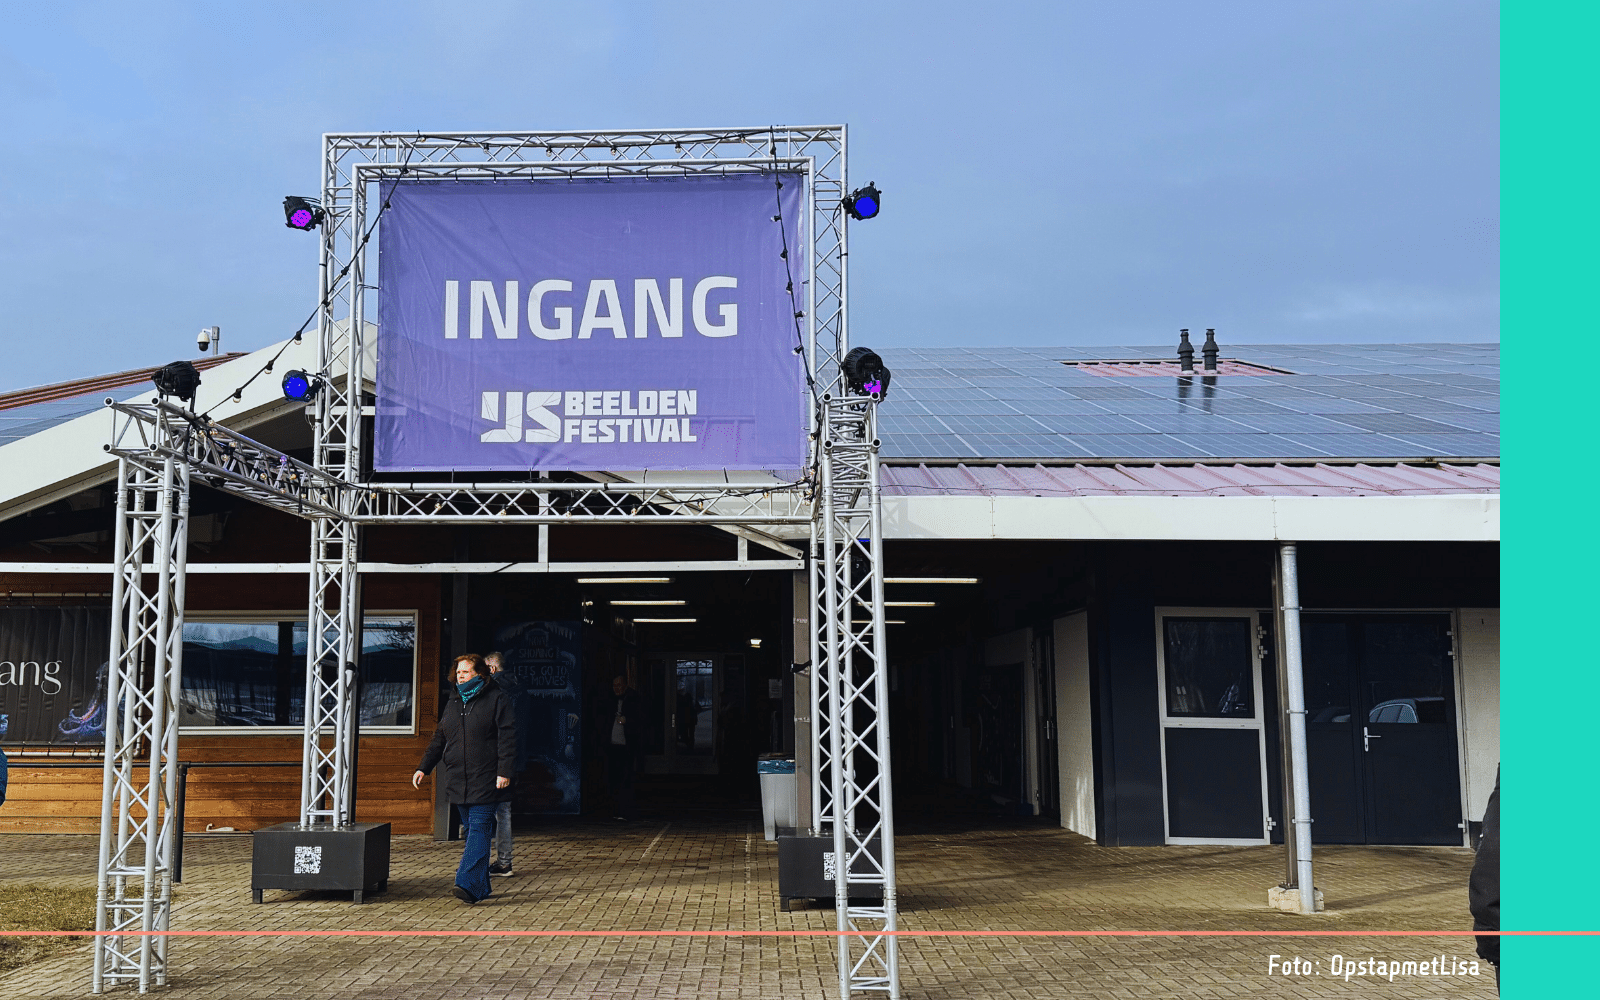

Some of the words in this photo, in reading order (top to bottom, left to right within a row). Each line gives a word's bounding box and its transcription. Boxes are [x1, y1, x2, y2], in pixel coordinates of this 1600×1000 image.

[444, 275, 738, 340] INGANG
[564, 390, 697, 416] BEELDEN
[564, 418, 697, 443] FESTIVAL
[531, 675, 566, 686] MOVIES
[540, 665, 554, 676] GO
